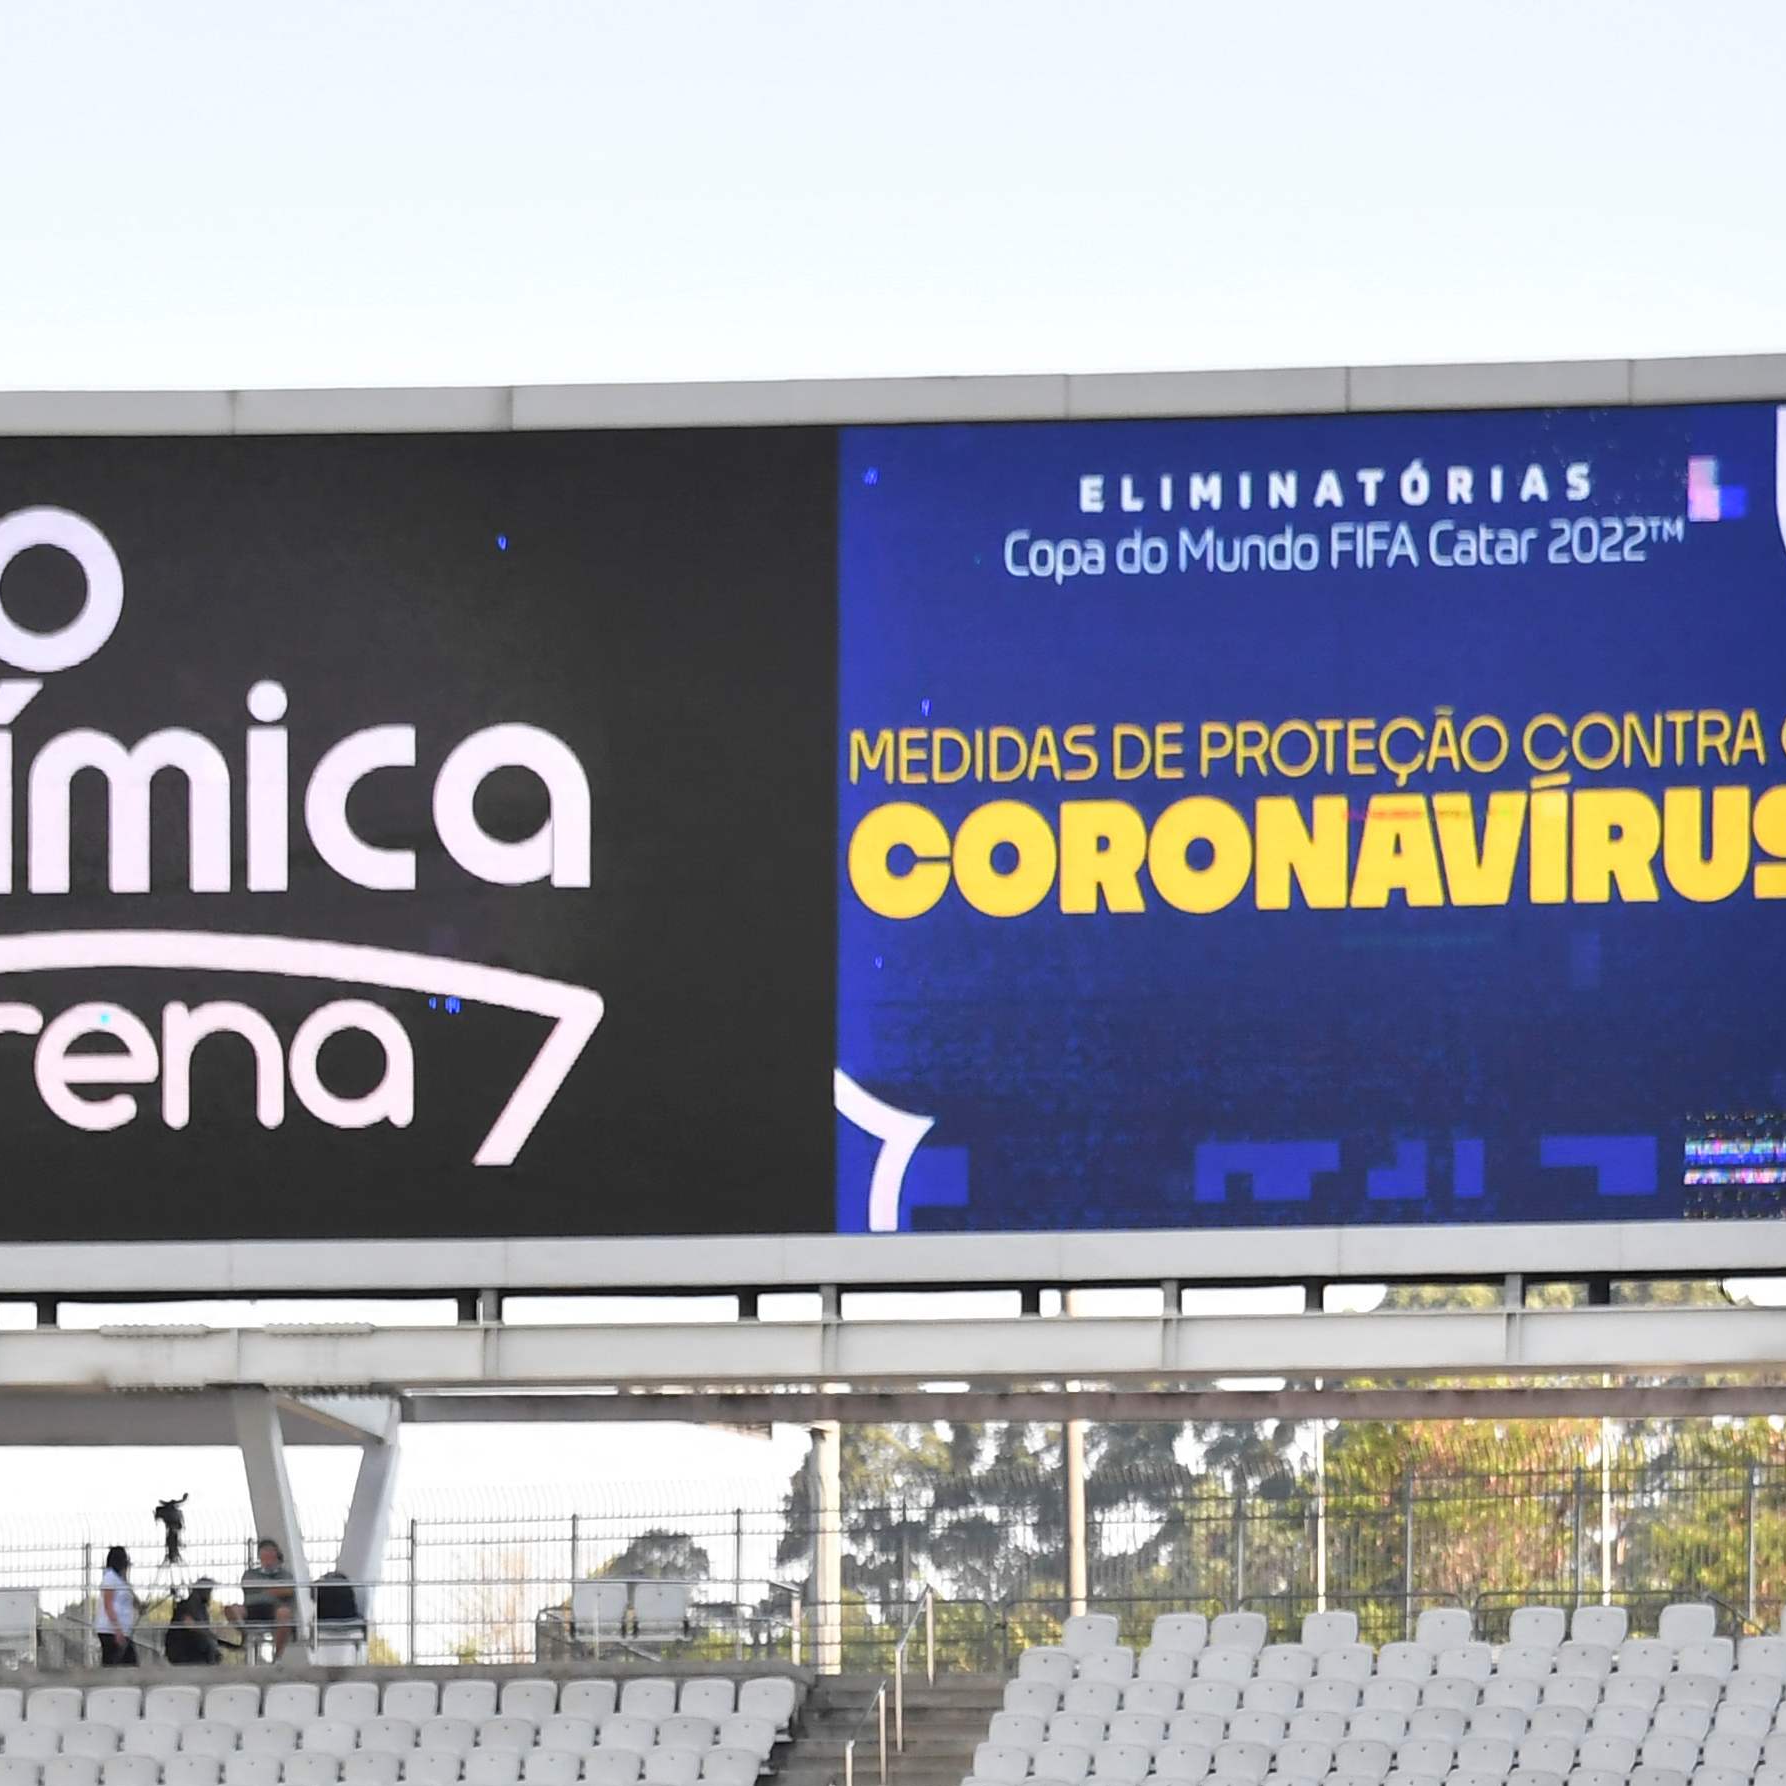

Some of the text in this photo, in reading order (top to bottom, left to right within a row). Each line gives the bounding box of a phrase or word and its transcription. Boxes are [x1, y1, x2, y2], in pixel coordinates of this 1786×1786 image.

[1079, 460, 1592, 513] ELIMINATÓRIAS
[1003, 529, 1105, 585] Copa
[1116, 527, 1168, 574] do
[1179, 523, 1316, 573] Mundo
[1330, 521, 1420, 570] FIFA
[1428, 520, 1537, 567] Catar
[849, 723, 1098, 786] MEDIDAS
[1112, 721, 1184, 781] DE
[1199, 706, 1511, 787] PROTEÇÃO
[1522, 708, 1765, 771] CONTRA
